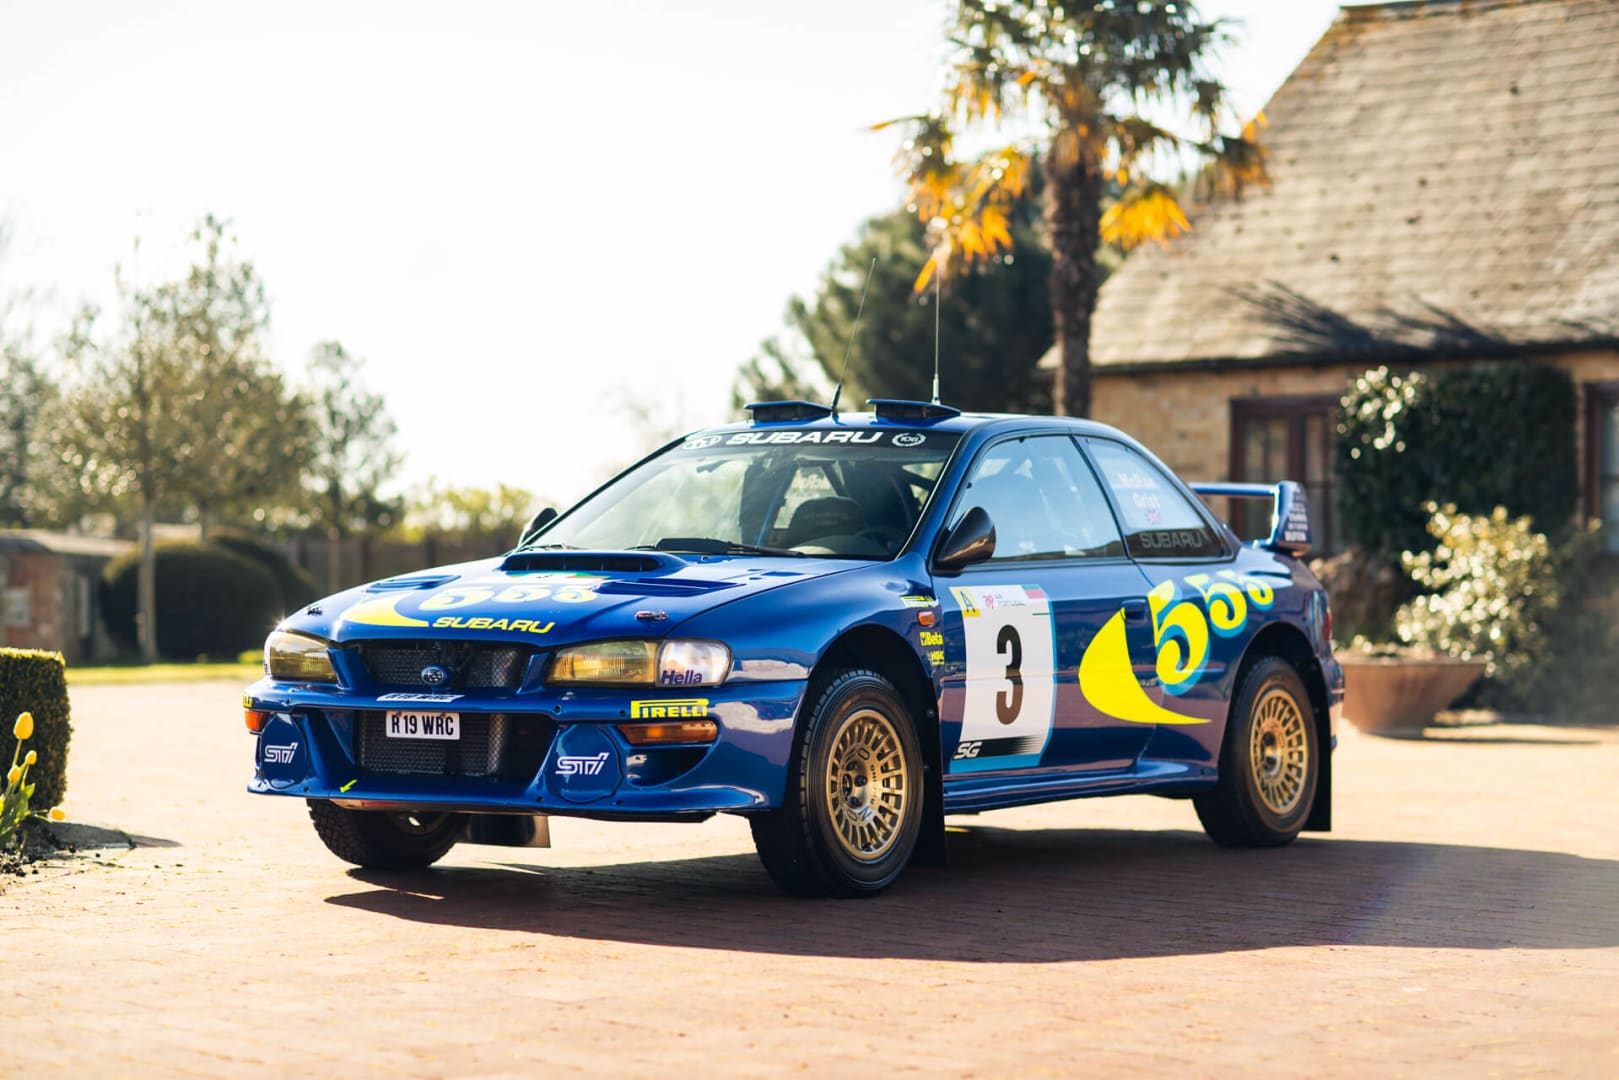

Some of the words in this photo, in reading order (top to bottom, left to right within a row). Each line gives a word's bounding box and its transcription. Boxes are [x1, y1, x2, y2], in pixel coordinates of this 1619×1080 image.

[726, 431, 884, 445] SUBARU
[1141, 532, 1202, 548] SUBARU
[960, 590, 976, 613] A
[432, 616, 556, 634] SUBARU
[1147, 570, 1275, 694] 555
[661, 669, 703, 685] Hella
[995, 624, 1024, 725] 3
[630, 698, 709, 718] PIRELLI
[391, 715, 400, 734] R
[403, 715, 417, 735] 19
[421, 715, 454, 736] WRC
[953, 741, 982, 760] SG
